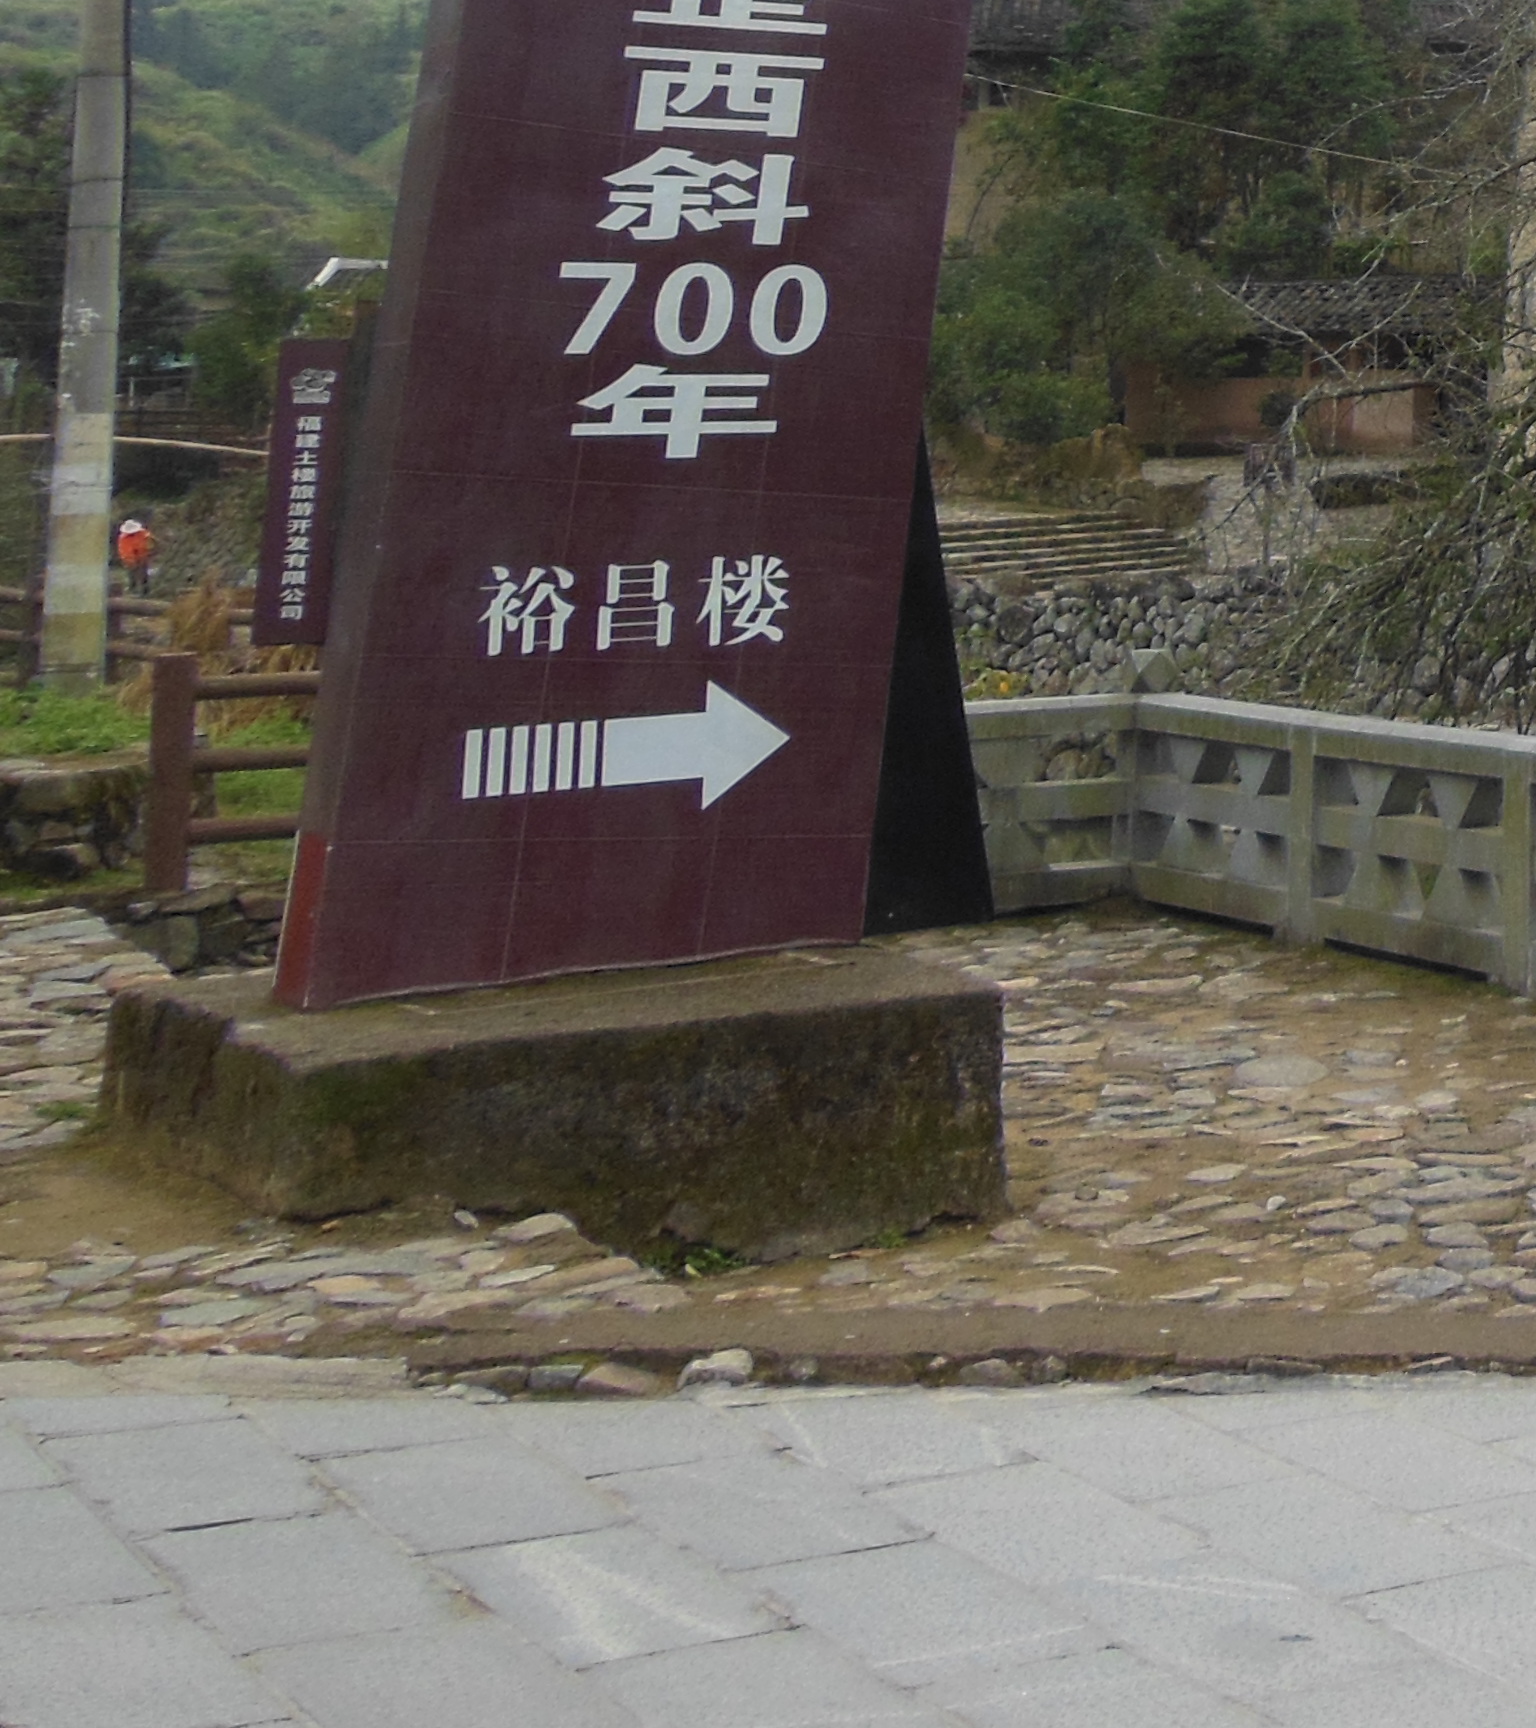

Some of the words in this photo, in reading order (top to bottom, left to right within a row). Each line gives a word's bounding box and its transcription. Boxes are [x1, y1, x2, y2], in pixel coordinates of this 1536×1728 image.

[279, 416, 322, 620] 福建土楼旅游开发有限公司
[479, 555, 789, 656] 裕昌楼
